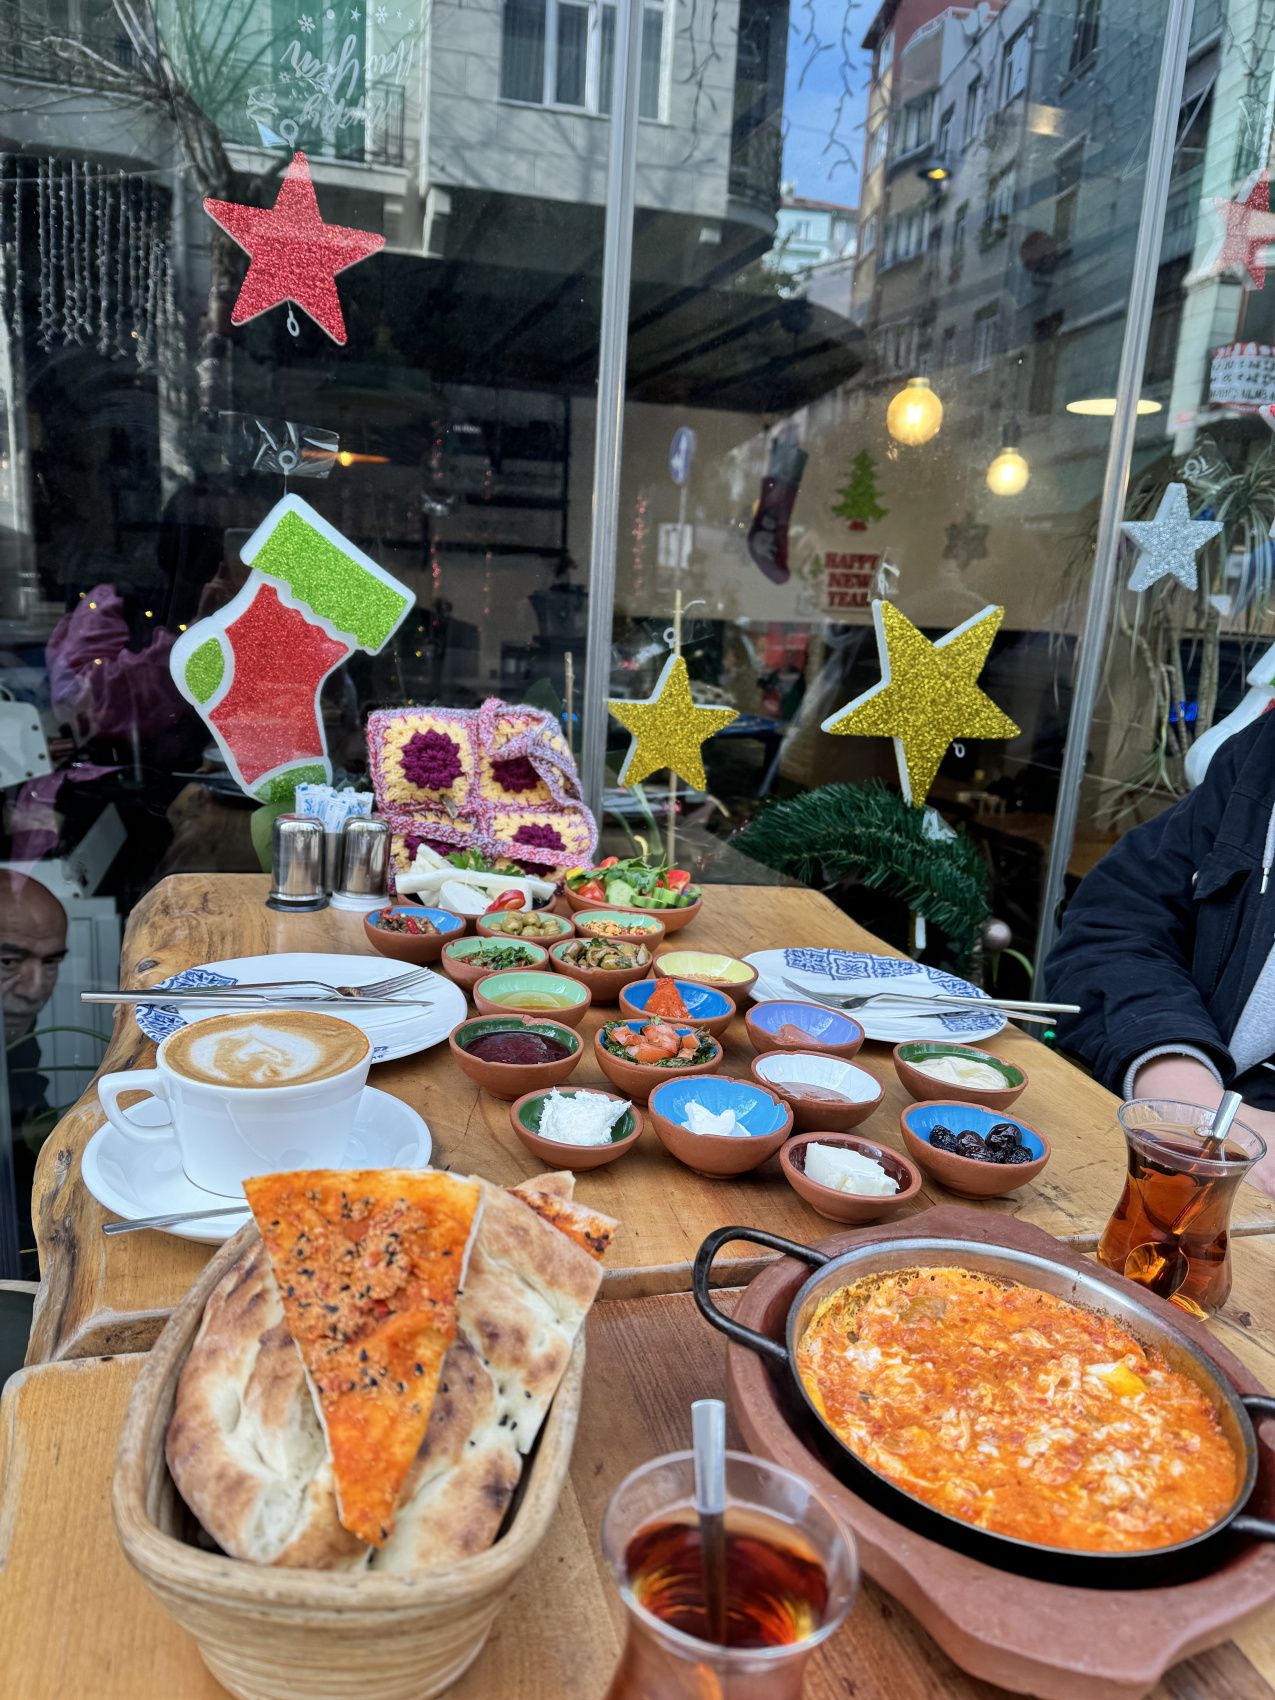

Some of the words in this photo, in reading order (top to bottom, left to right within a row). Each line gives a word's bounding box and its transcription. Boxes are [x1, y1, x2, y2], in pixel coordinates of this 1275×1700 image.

[280, 34, 360, 100] Year
[826, 552, 880, 570] HAPPY
[828, 573, 872, 589] NEW
